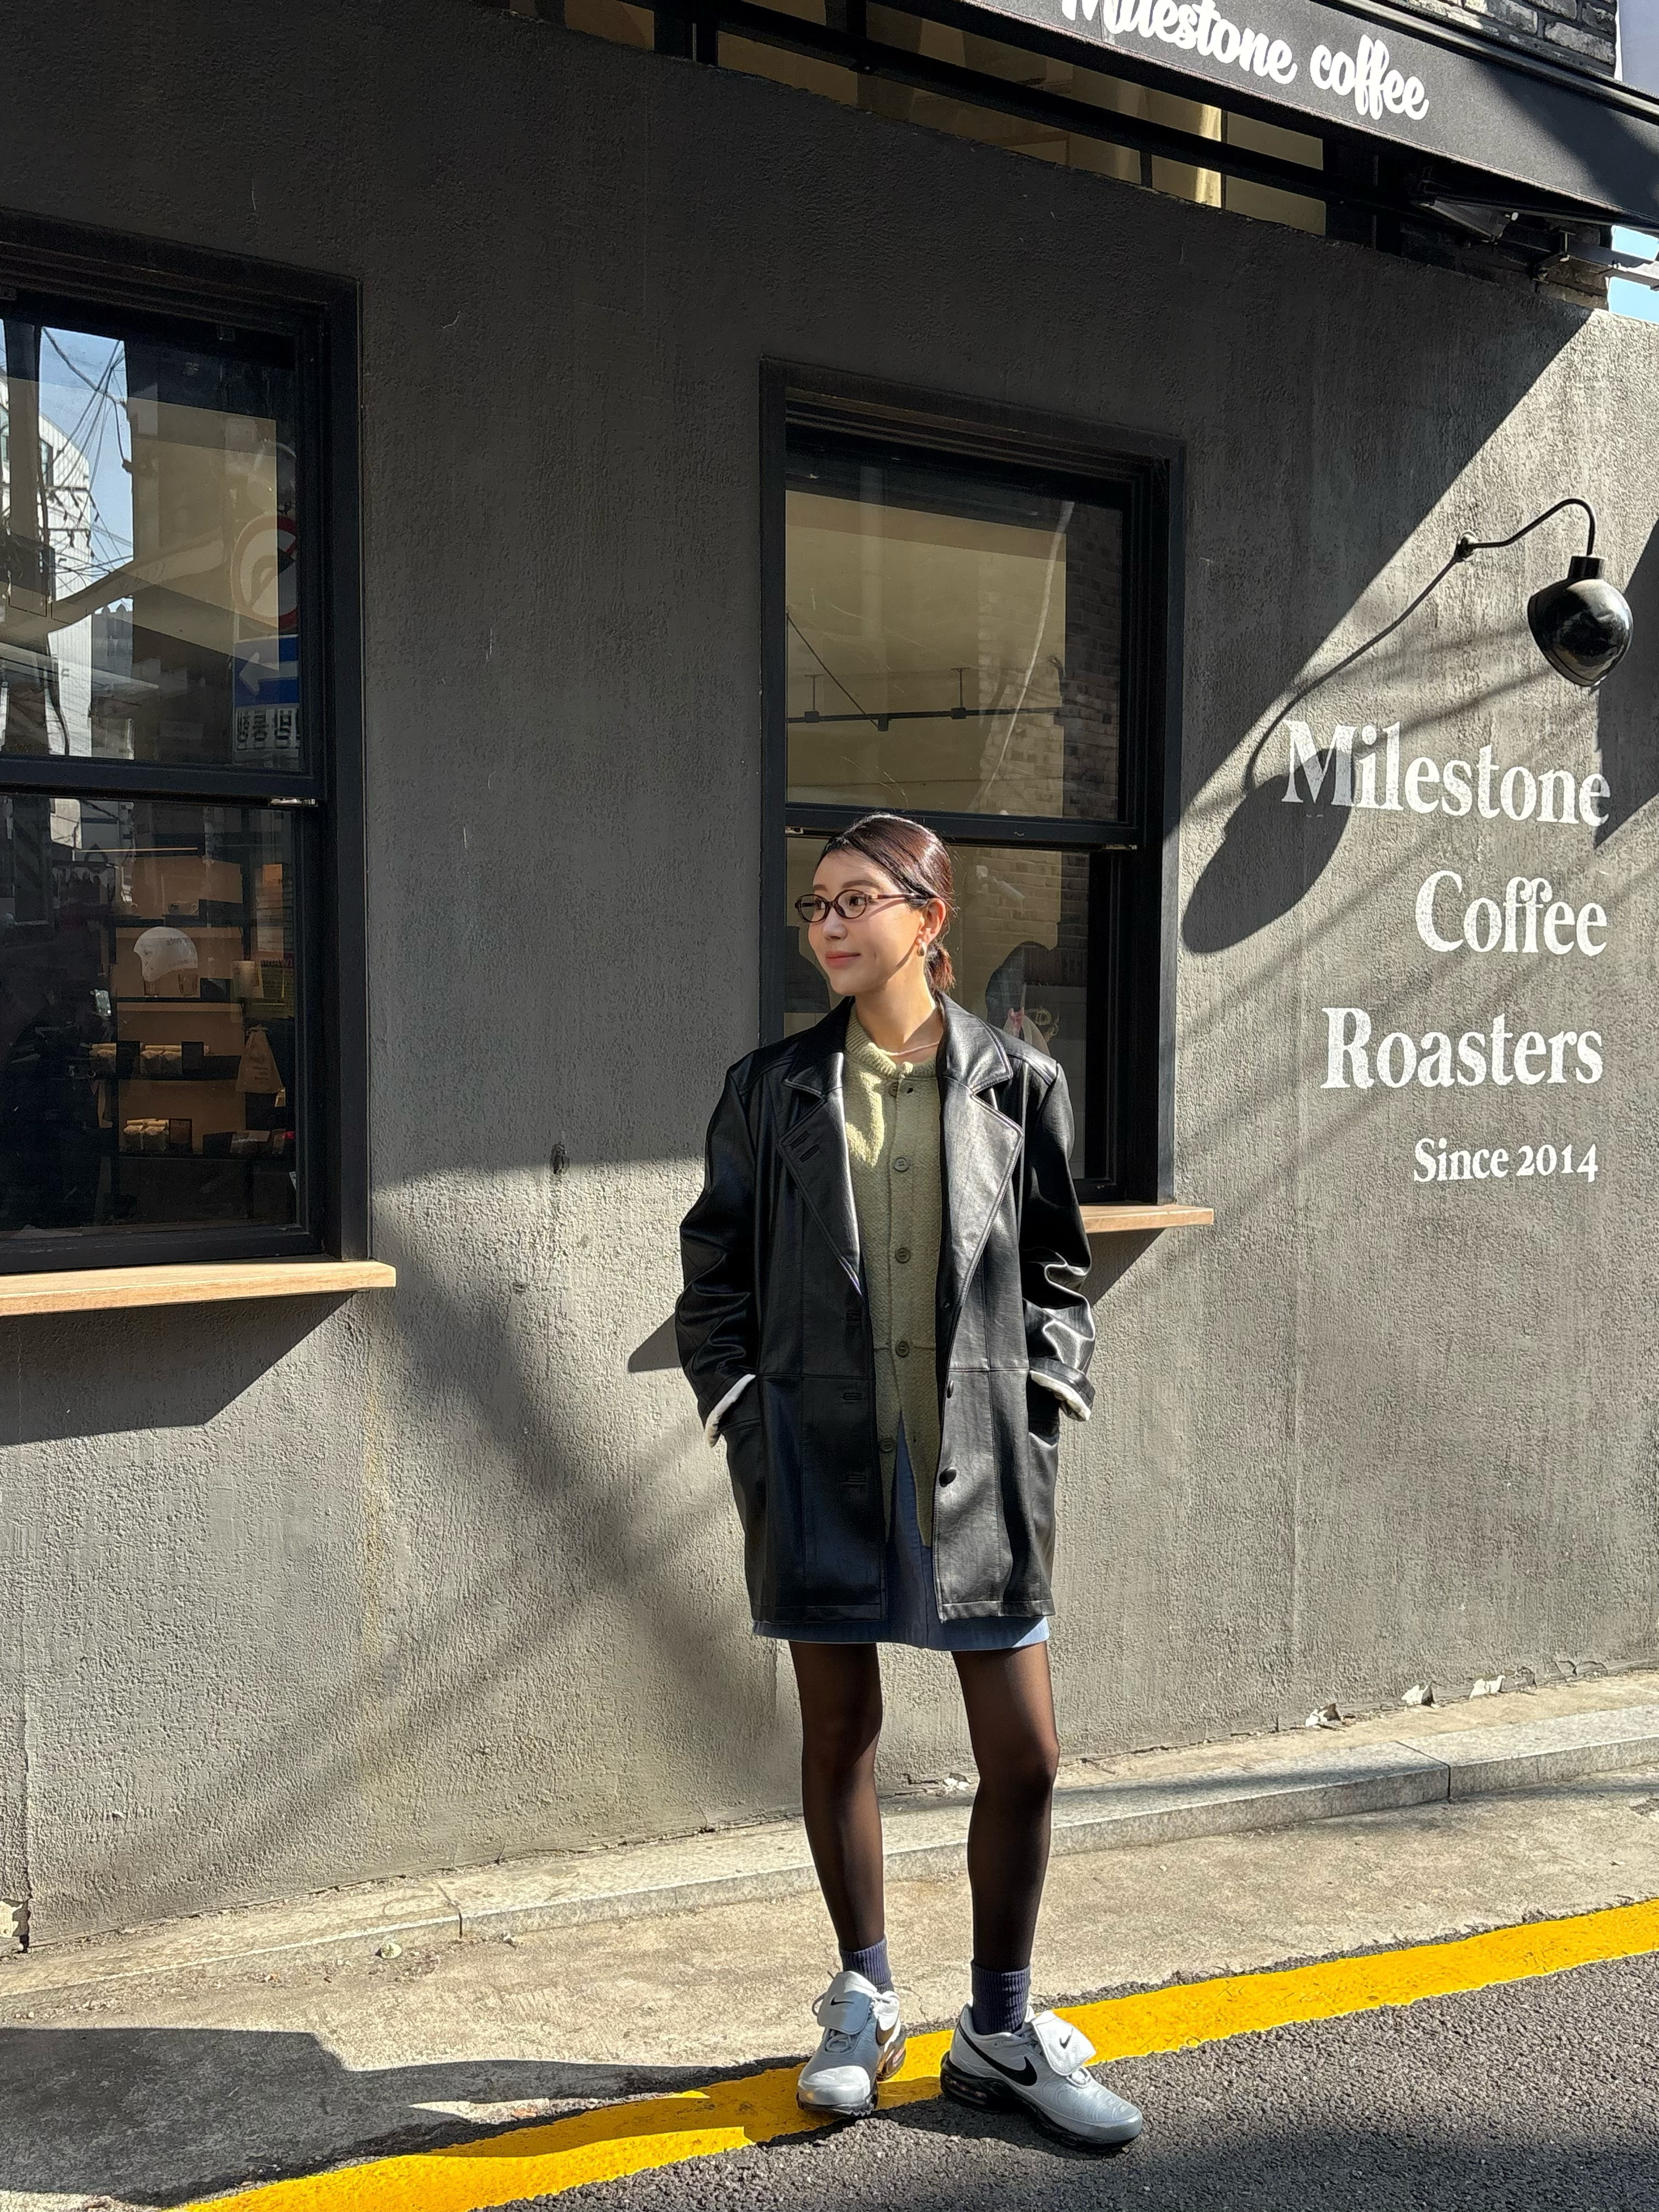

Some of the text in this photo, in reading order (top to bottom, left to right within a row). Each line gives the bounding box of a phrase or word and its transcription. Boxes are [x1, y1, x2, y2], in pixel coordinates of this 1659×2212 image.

[1310, 33, 1430, 121] coffee
[1282, 719, 1611, 827] Milestone
[1415, 870, 1608, 957] Coffee
[1320, 1007, 1604, 1090] Roasters
[1413, 1137, 1599, 1183] Since 2014
